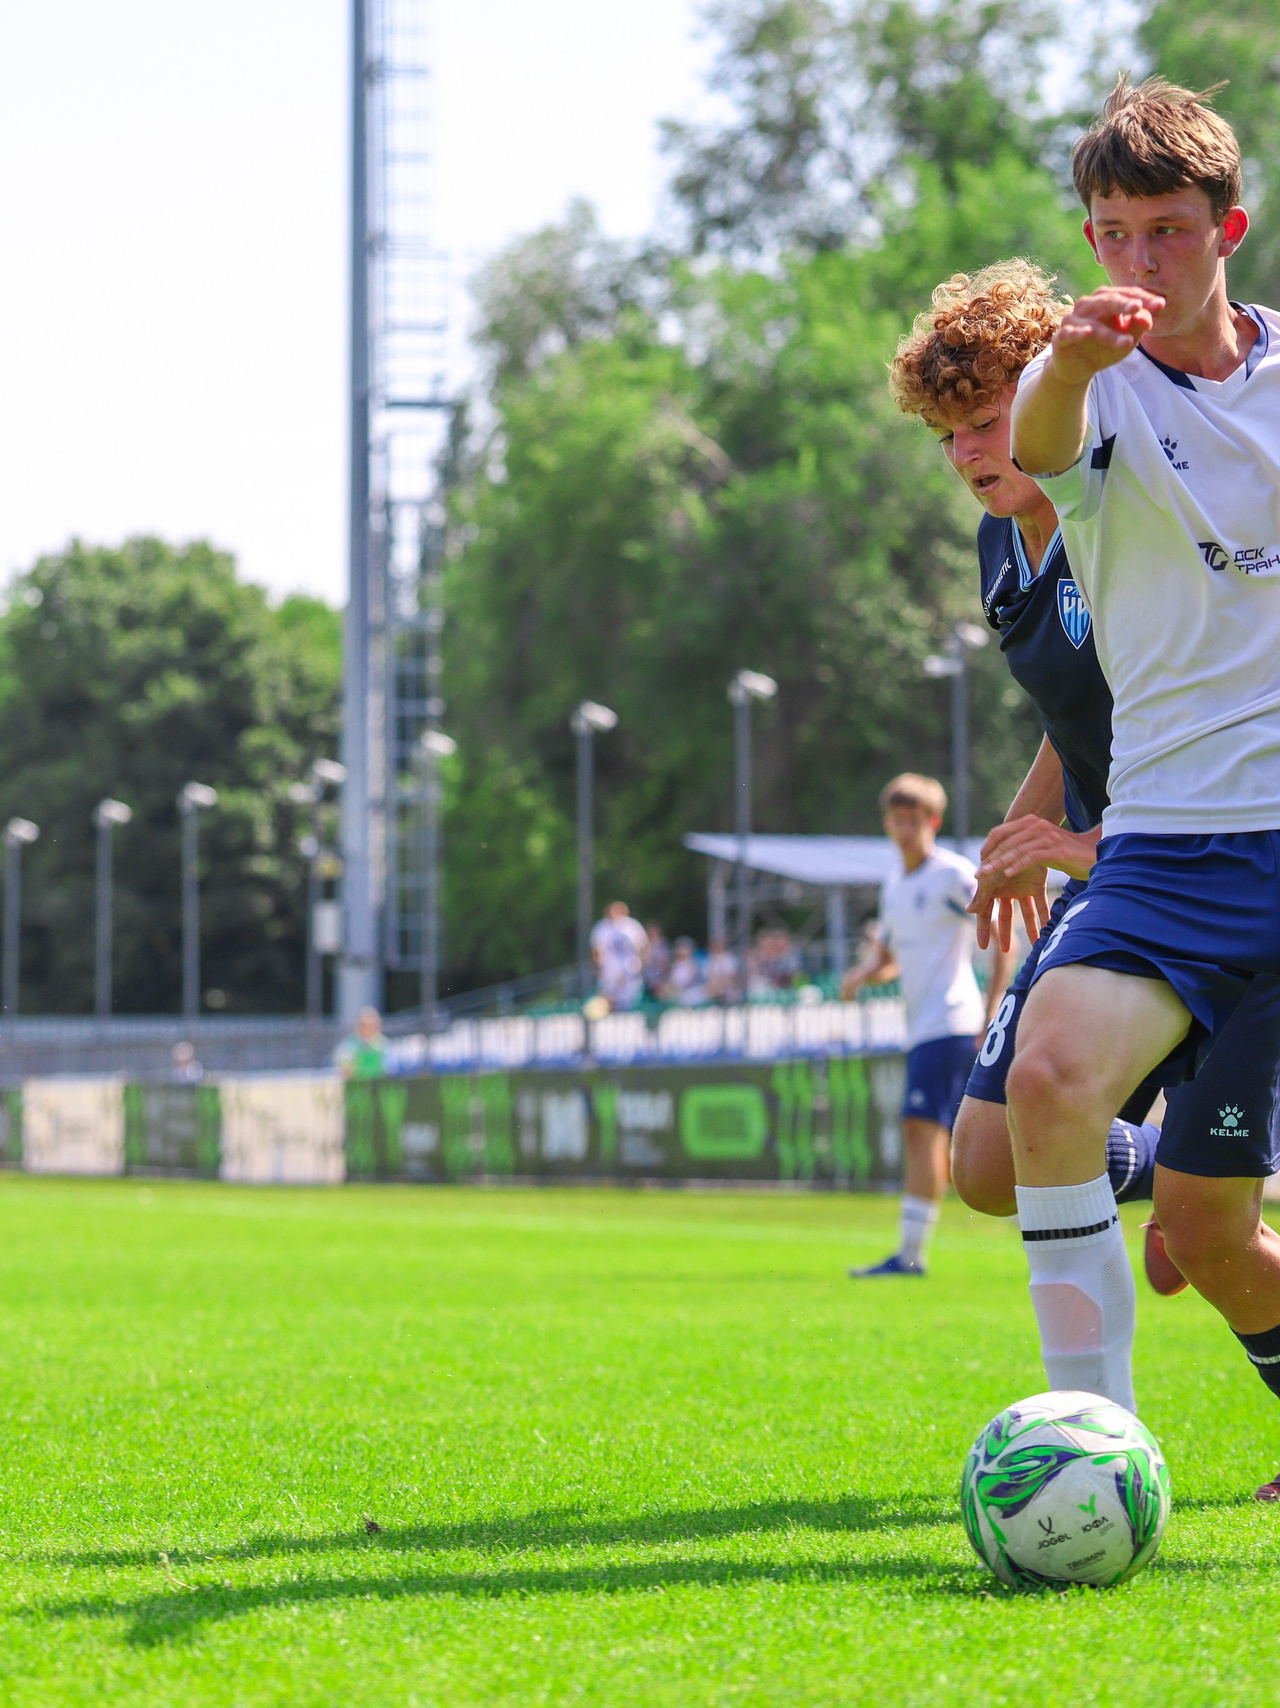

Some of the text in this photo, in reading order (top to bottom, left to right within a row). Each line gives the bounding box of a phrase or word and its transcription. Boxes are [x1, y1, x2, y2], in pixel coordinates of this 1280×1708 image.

[1233, 546, 1265, 563] ДСК
[976, 994, 1017, 1067] 8
[1210, 1127, 1250, 1137] KELME
